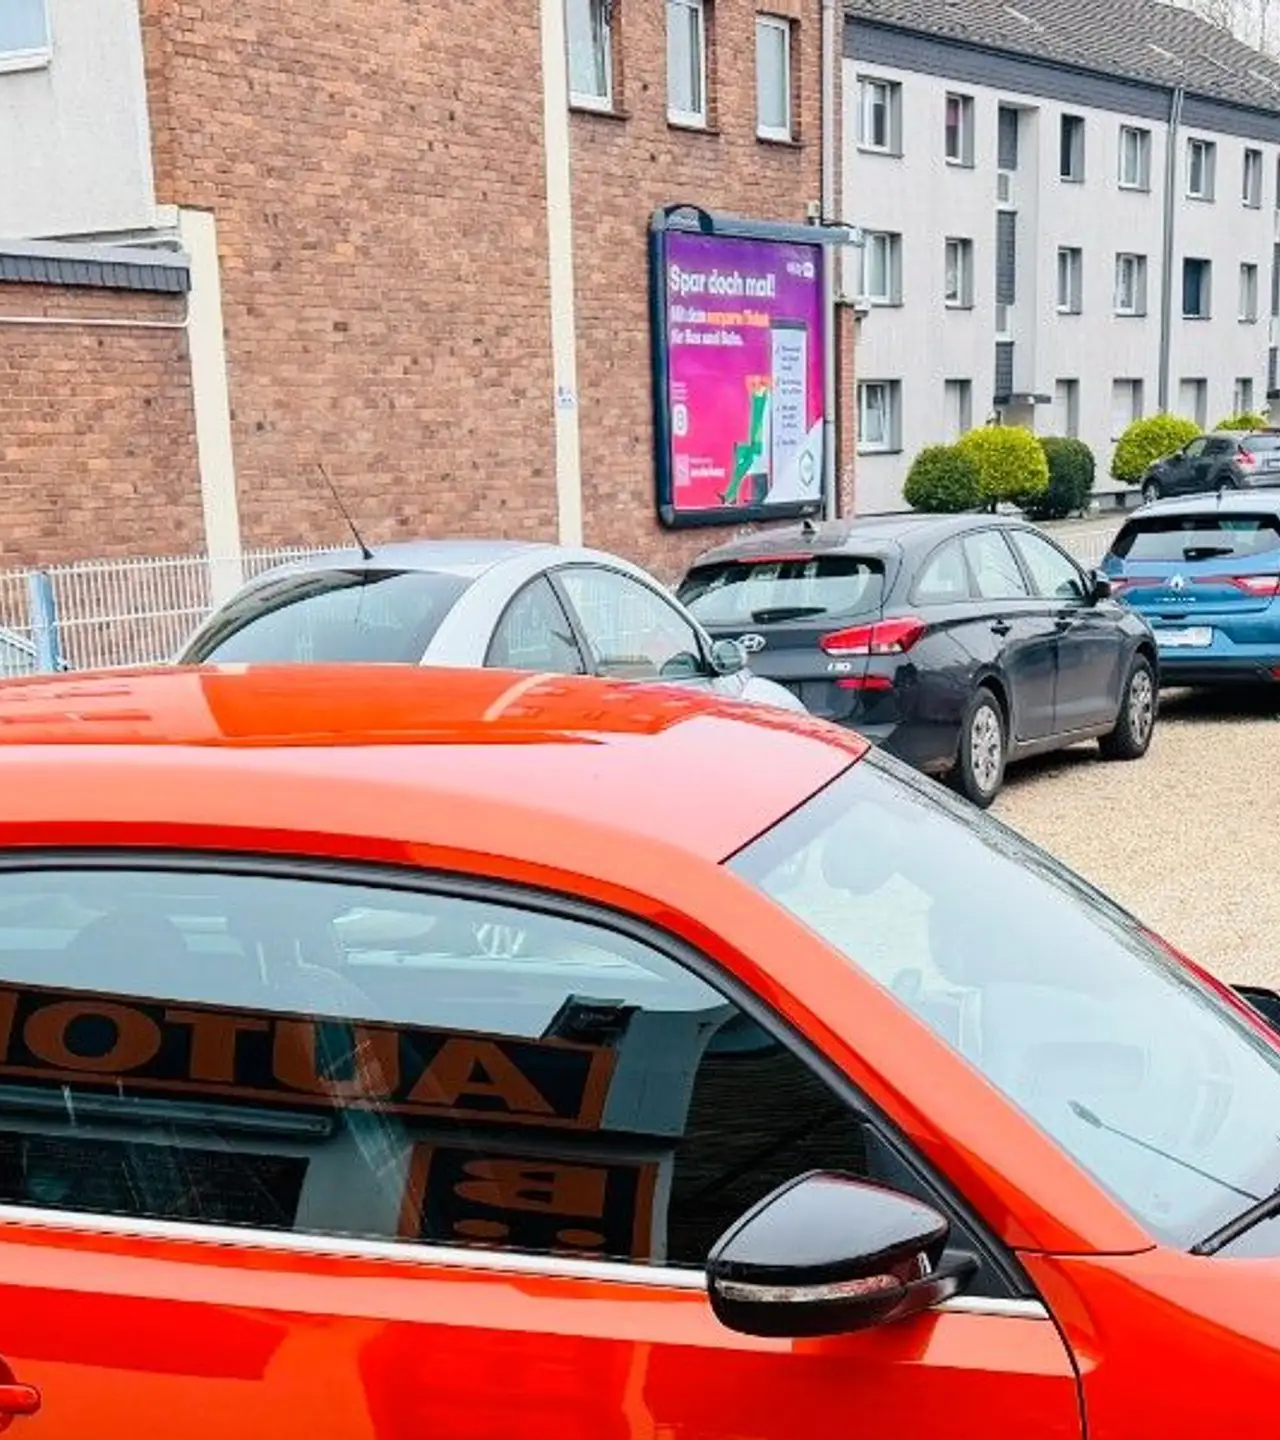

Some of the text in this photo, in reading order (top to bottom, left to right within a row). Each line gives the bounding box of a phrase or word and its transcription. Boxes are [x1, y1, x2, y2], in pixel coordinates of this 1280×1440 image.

[671, 264, 775, 299] Spar doch mal!
